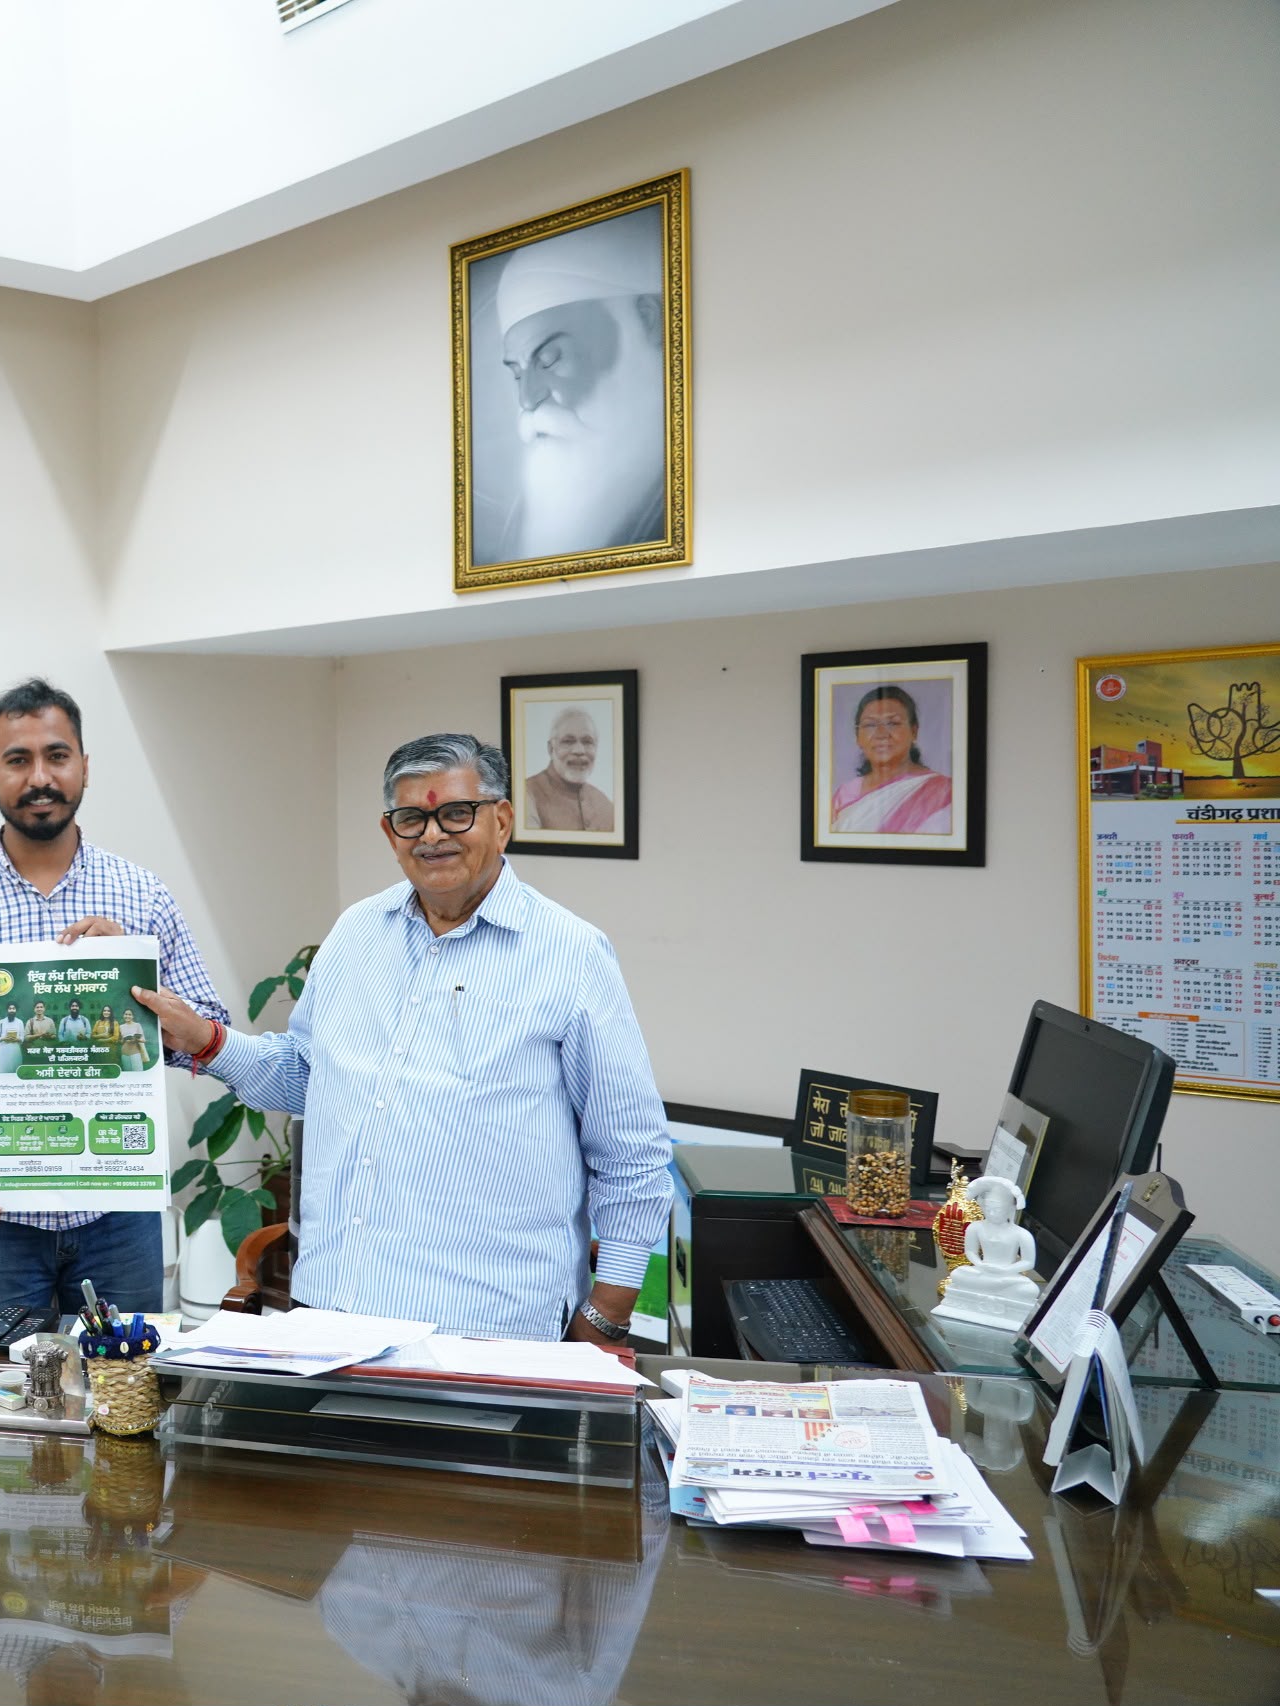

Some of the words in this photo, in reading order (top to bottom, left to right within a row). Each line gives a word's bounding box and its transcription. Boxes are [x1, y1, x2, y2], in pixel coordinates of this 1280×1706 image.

[1186, 804, 1243, 823] चंडीगढ़
[27, 970, 47, 982] ਇੱਕ
[48, 970, 65, 981] ਲੱਖ
[33, 983, 53, 994] ਇੱਕ
[54, 982, 72, 993] ਲੱਖ
[73, 983, 108, 995] ਮੁਸਕਾਨ
[812, 1091, 831, 1115] मेरा
[810, 1117, 826, 1139] जो
